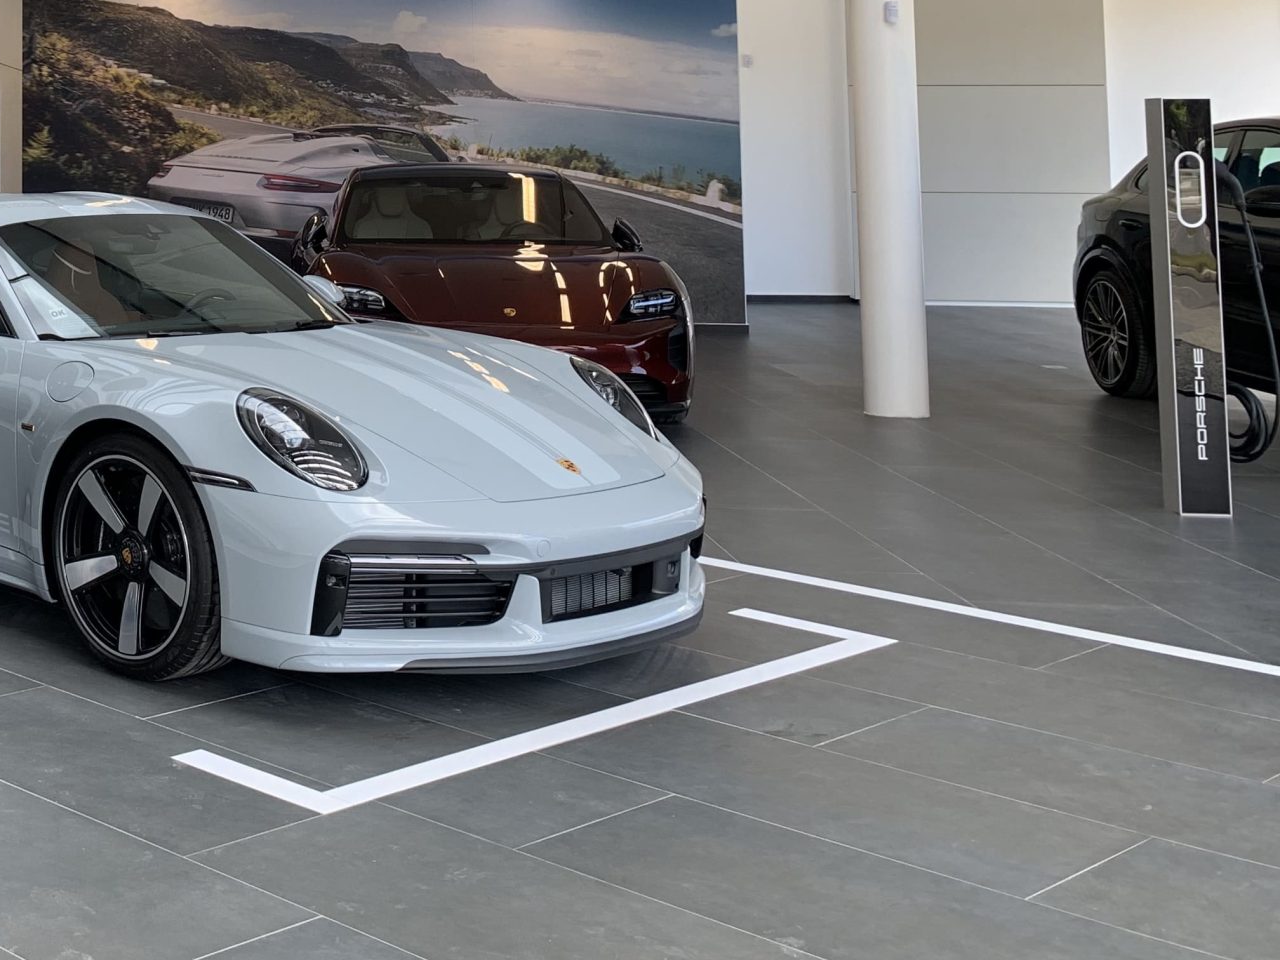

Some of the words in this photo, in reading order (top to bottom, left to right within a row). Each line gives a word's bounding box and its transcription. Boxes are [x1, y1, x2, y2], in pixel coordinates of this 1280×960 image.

[207, 206, 231, 220] 1948
[50, 309, 66, 318] OK
[1193, 348, 1208, 461] PORSCHE
